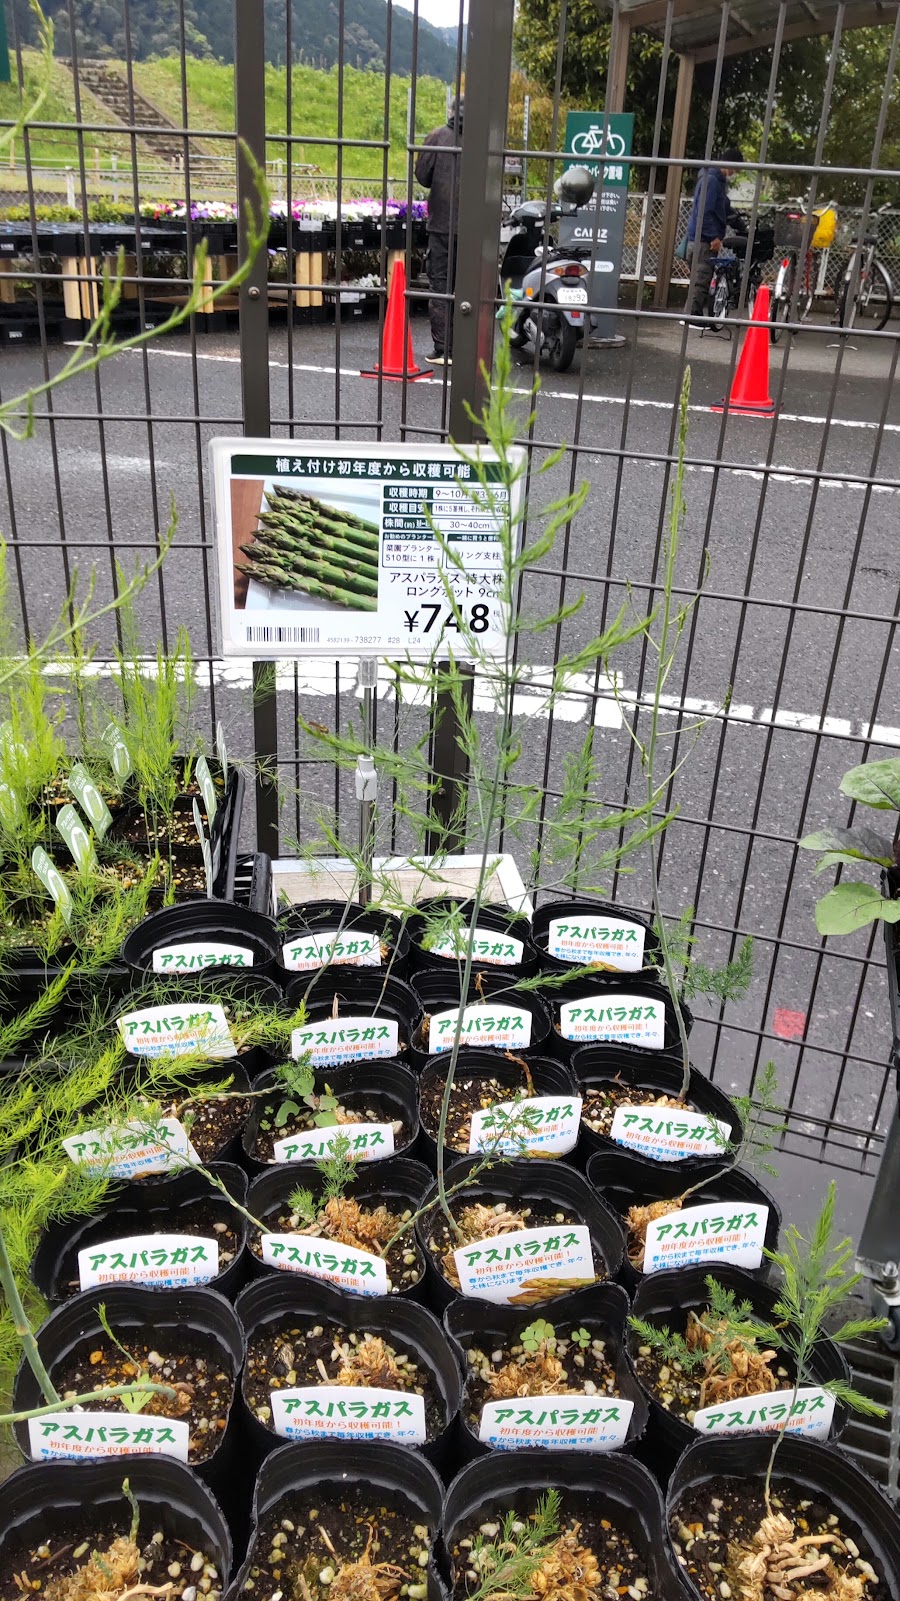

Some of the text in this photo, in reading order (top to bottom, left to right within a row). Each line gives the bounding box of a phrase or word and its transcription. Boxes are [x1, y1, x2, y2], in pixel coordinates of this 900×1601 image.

[574, 228, 608, 239] CAIZ
[276, 457, 471, 479] 植え付け初年度から収穫可能
[389, 487, 428, 499] 収穫時期
[449, 521, 492, 530] 30〜40cm
[386, 544, 441, 554] 菜園プランター
[390, 571, 460, 585] アスパラガス
[404, 604, 490, 635] ¥748
[408, 637, 422, 646] L24
[556, 924, 638, 942] アスパラガス
[290, 939, 372, 961] アスパラガス
[160, 954, 246, 968] アスパラガス
[125, 1011, 218, 1036] アスパラガス
[568, 1006, 657, 1023] アスパラガス
[437, 1016, 524, 1034] アスパラガス
[300, 1026, 391, 1046] アスパラガス
[480, 1104, 574, 1131] アスラガス
[622, 1114, 720, 1141] アスパラガス
[283, 1131, 386, 1160] アスパガス
[625, 1131, 709, 1151] 初年度から収穫可能！
[656, 1212, 760, 1242] アスパラガス
[463, 1232, 581, 1268] アスパラガス
[661, 1233, 748, 1252] 初年度から収穫可能！
[88, 1245, 209, 1272] アスパラガス
[269, 1241, 378, 1278] アスパラガス
[475, 1250, 571, 1275] 初年度から収穫可能！
[97, 1267, 197, 1284] 初年度から収穫可能！
[281, 1398, 415, 1420] アスパラガス
[494, 1407, 622, 1427] アスパラガス
[705, 1395, 826, 1430] アスパラガス
[39, 1422, 177, 1444] アスパラガス
[293, 1417, 401, 1429] 初年度から収穫可能！
[499, 1426, 606, 1437] 初年度から収穫可能！
